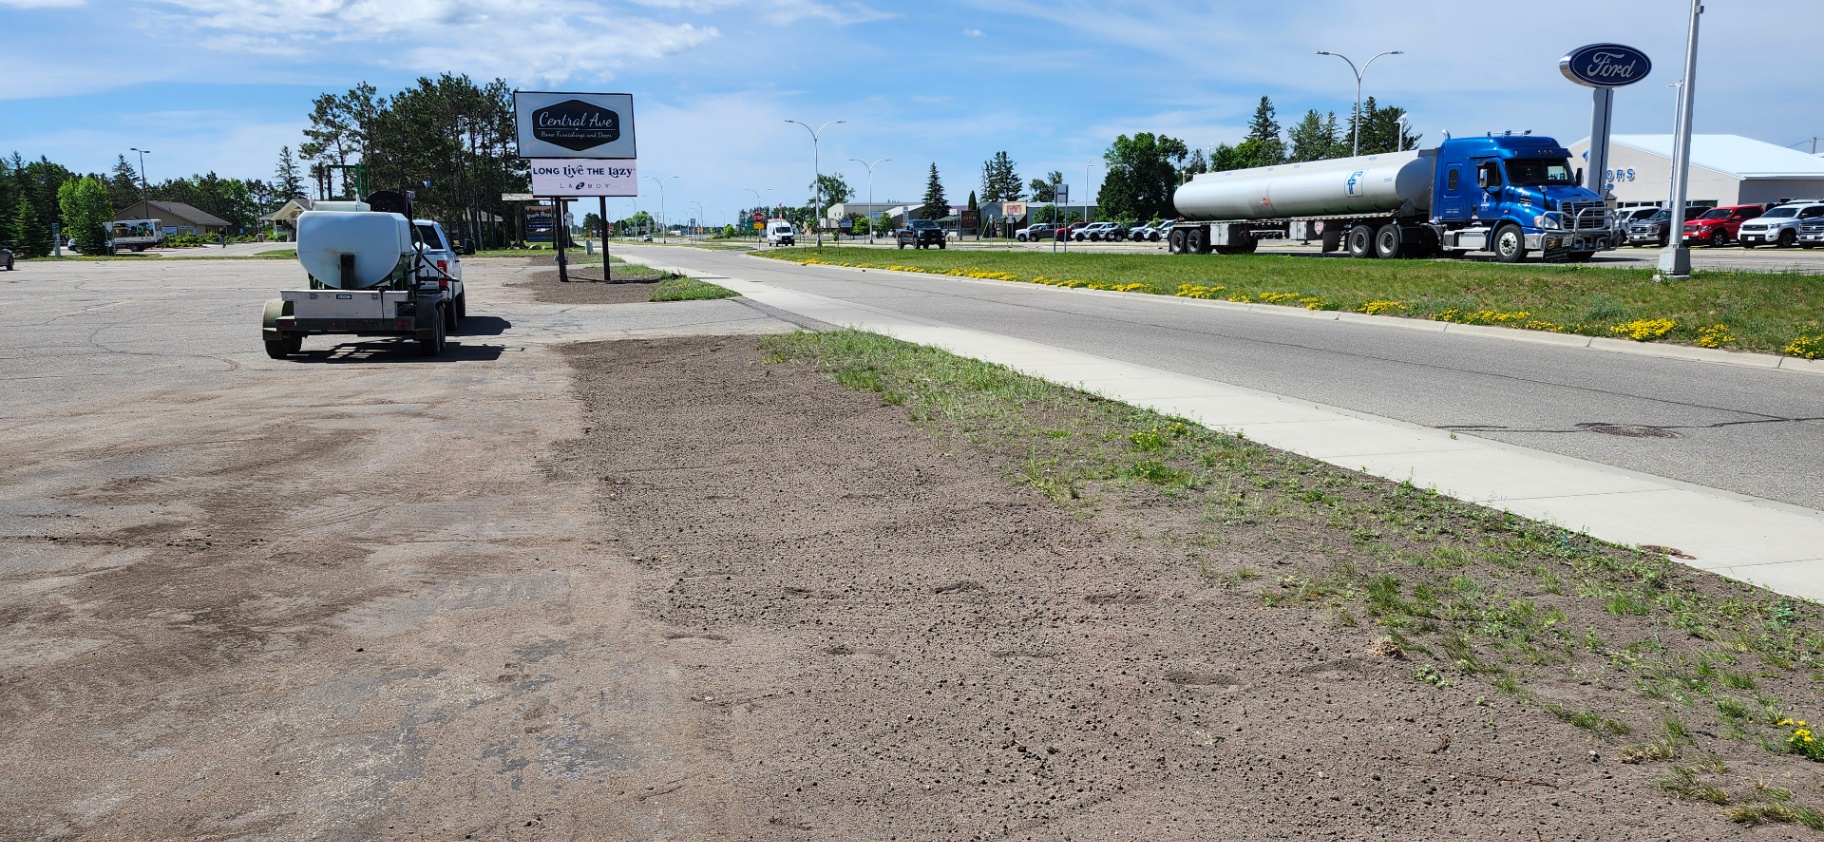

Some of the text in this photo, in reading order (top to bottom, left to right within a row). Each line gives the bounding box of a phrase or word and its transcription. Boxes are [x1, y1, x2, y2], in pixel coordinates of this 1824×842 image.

[1587, 52, 1637, 78] Ford
[539, 111, 613, 127] Central Ave
[556, 131, 585, 139] Furnishings
[533, 167, 560, 175] LONG
[563, 165, 584, 178] Live
[608, 166, 633, 178] Lazy
